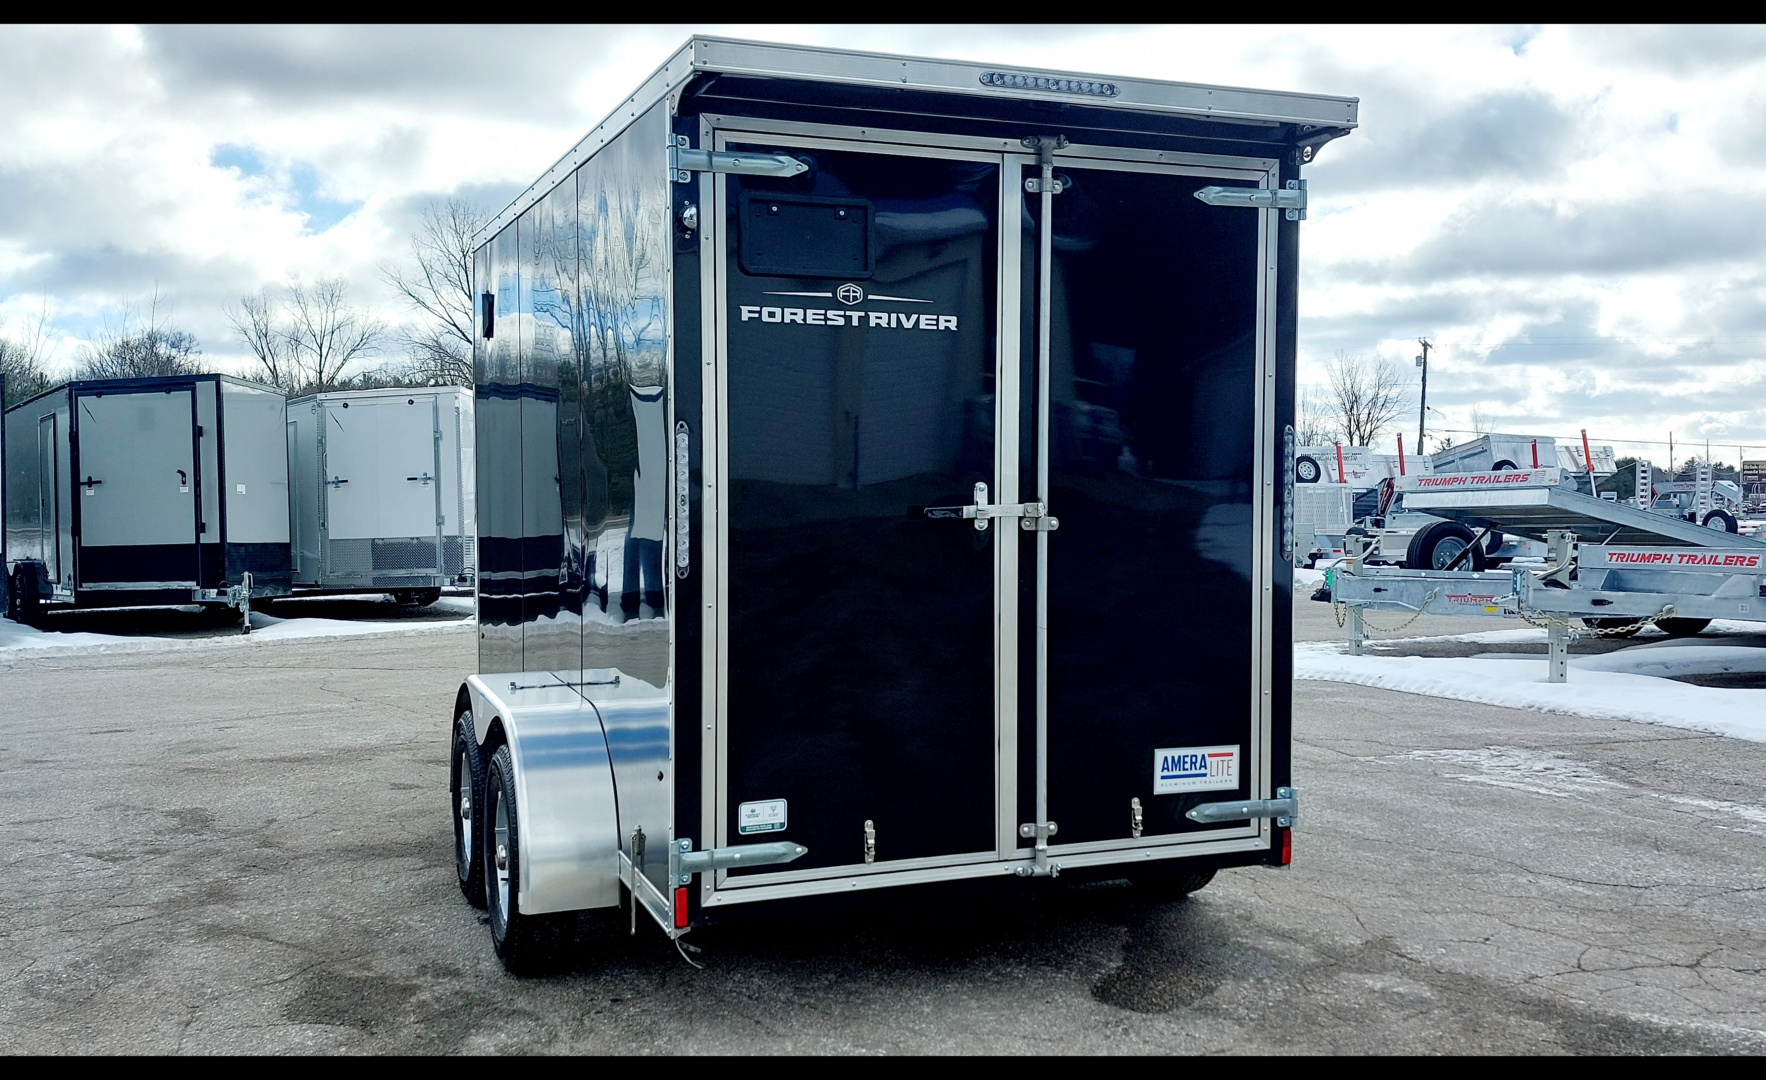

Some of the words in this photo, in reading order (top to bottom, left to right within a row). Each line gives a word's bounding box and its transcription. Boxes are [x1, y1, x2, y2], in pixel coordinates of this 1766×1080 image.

[740, 305, 865, 327] FOREST
[868, 311, 958, 331] RIVER
[1418, 476, 1468, 487] TRIUMPH
[1470, 473, 1531, 485] TRAILERS
[1607, 552, 1674, 564] TRIUMPH
[1677, 553, 1760, 567] TRAILERS
[1161, 753, 1208, 773] AMERA
[1209, 759, 1233, 777] LITE
